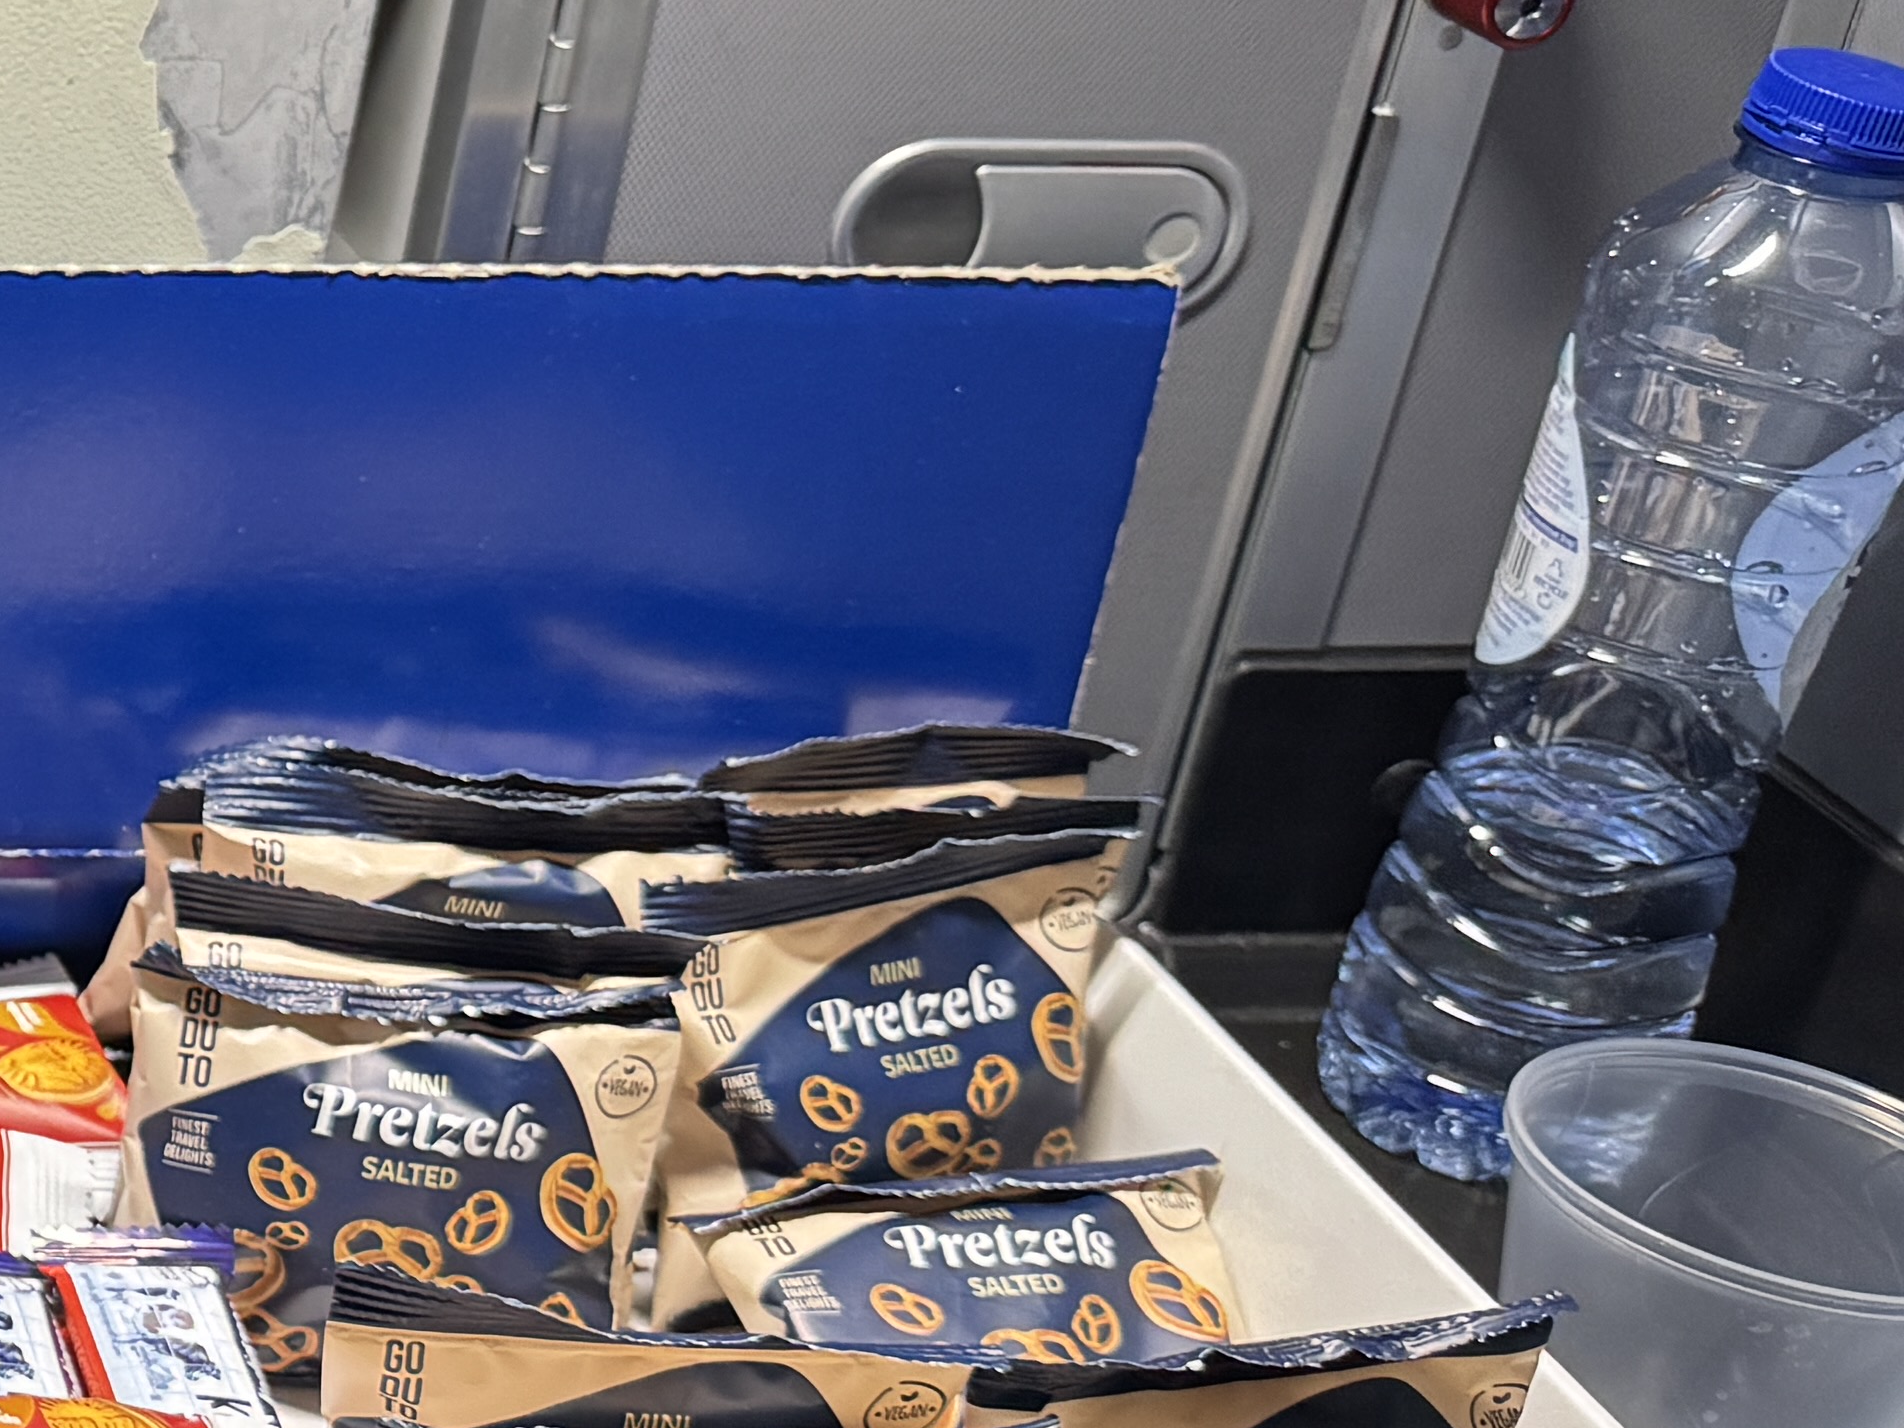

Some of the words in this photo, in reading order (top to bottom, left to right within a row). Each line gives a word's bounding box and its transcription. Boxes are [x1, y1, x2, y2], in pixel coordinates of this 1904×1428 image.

[252, 837, 285, 866] GO
[443, 896, 505, 920] MINI
[208, 941, 243, 969] GO
[692, 944, 720, 976] GO
[869, 957, 921, 987] MINI
[185, 986, 222, 1018] GO
[805, 963, 1020, 1054] Pretzels
[179, 1015, 219, 1052] DU
[700, 1013, 737, 1046] TO
[177, 1052, 214, 1088] TO
[880, 1045, 961, 1079] SALTED
[387, 1068, 450, 1098] MINI
[302, 1081, 550, 1163] Pretzels
[361, 1155, 460, 1190] SALTED
[752, 1235, 798, 1259] TO
[883, 1212, 1117, 1271] Pretzels
[966, 1273, 1067, 1298] SALTED
[383, 1338, 426, 1374] GO
